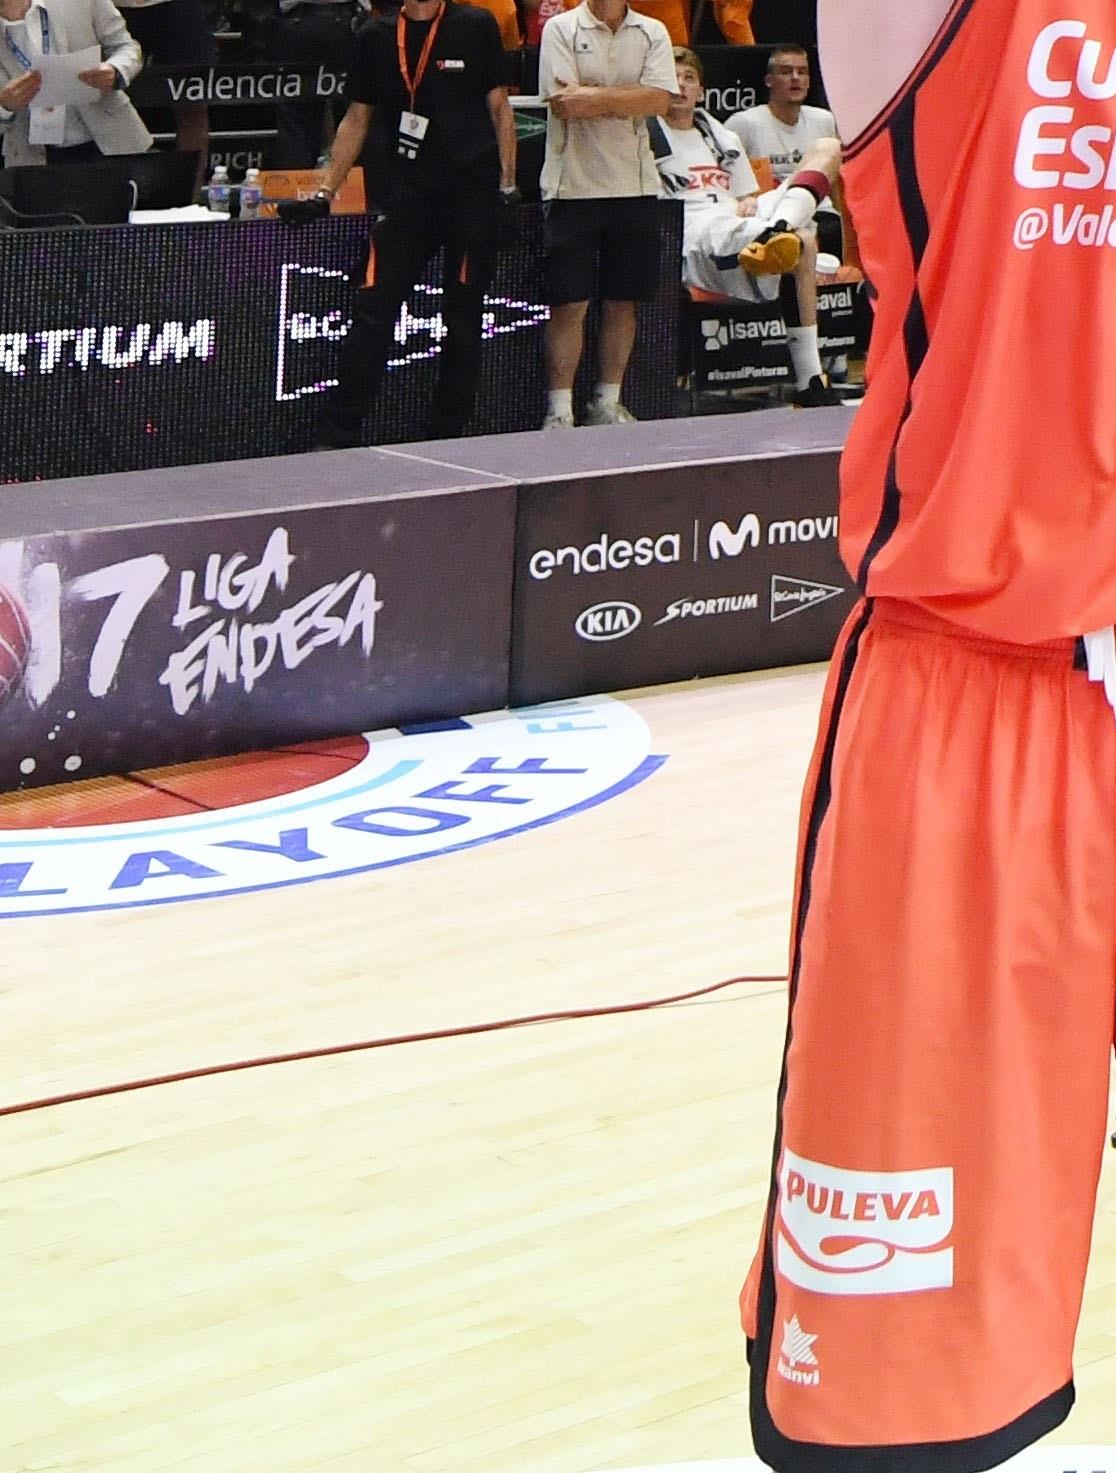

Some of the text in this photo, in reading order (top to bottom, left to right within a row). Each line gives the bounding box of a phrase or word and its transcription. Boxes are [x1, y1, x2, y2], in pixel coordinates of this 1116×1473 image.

[167, 67, 301, 102] valencia
[210, 151, 264, 169] RICH
[0, 319, 215, 376] RTIUM
[728, 316, 788, 341] isaval
[529, 532, 680, 580] endesa
[768, 516, 838, 545] movi
[172, 527, 296, 629] LIGA
[586, 608, 631, 634] KIA
[653, 593, 758, 626] SPORTIUM
[160, 569, 384, 716] ENDESA
[0, 754, 589, 899] LAYOFF
[786, 1170, 941, 1221] PULEVA
